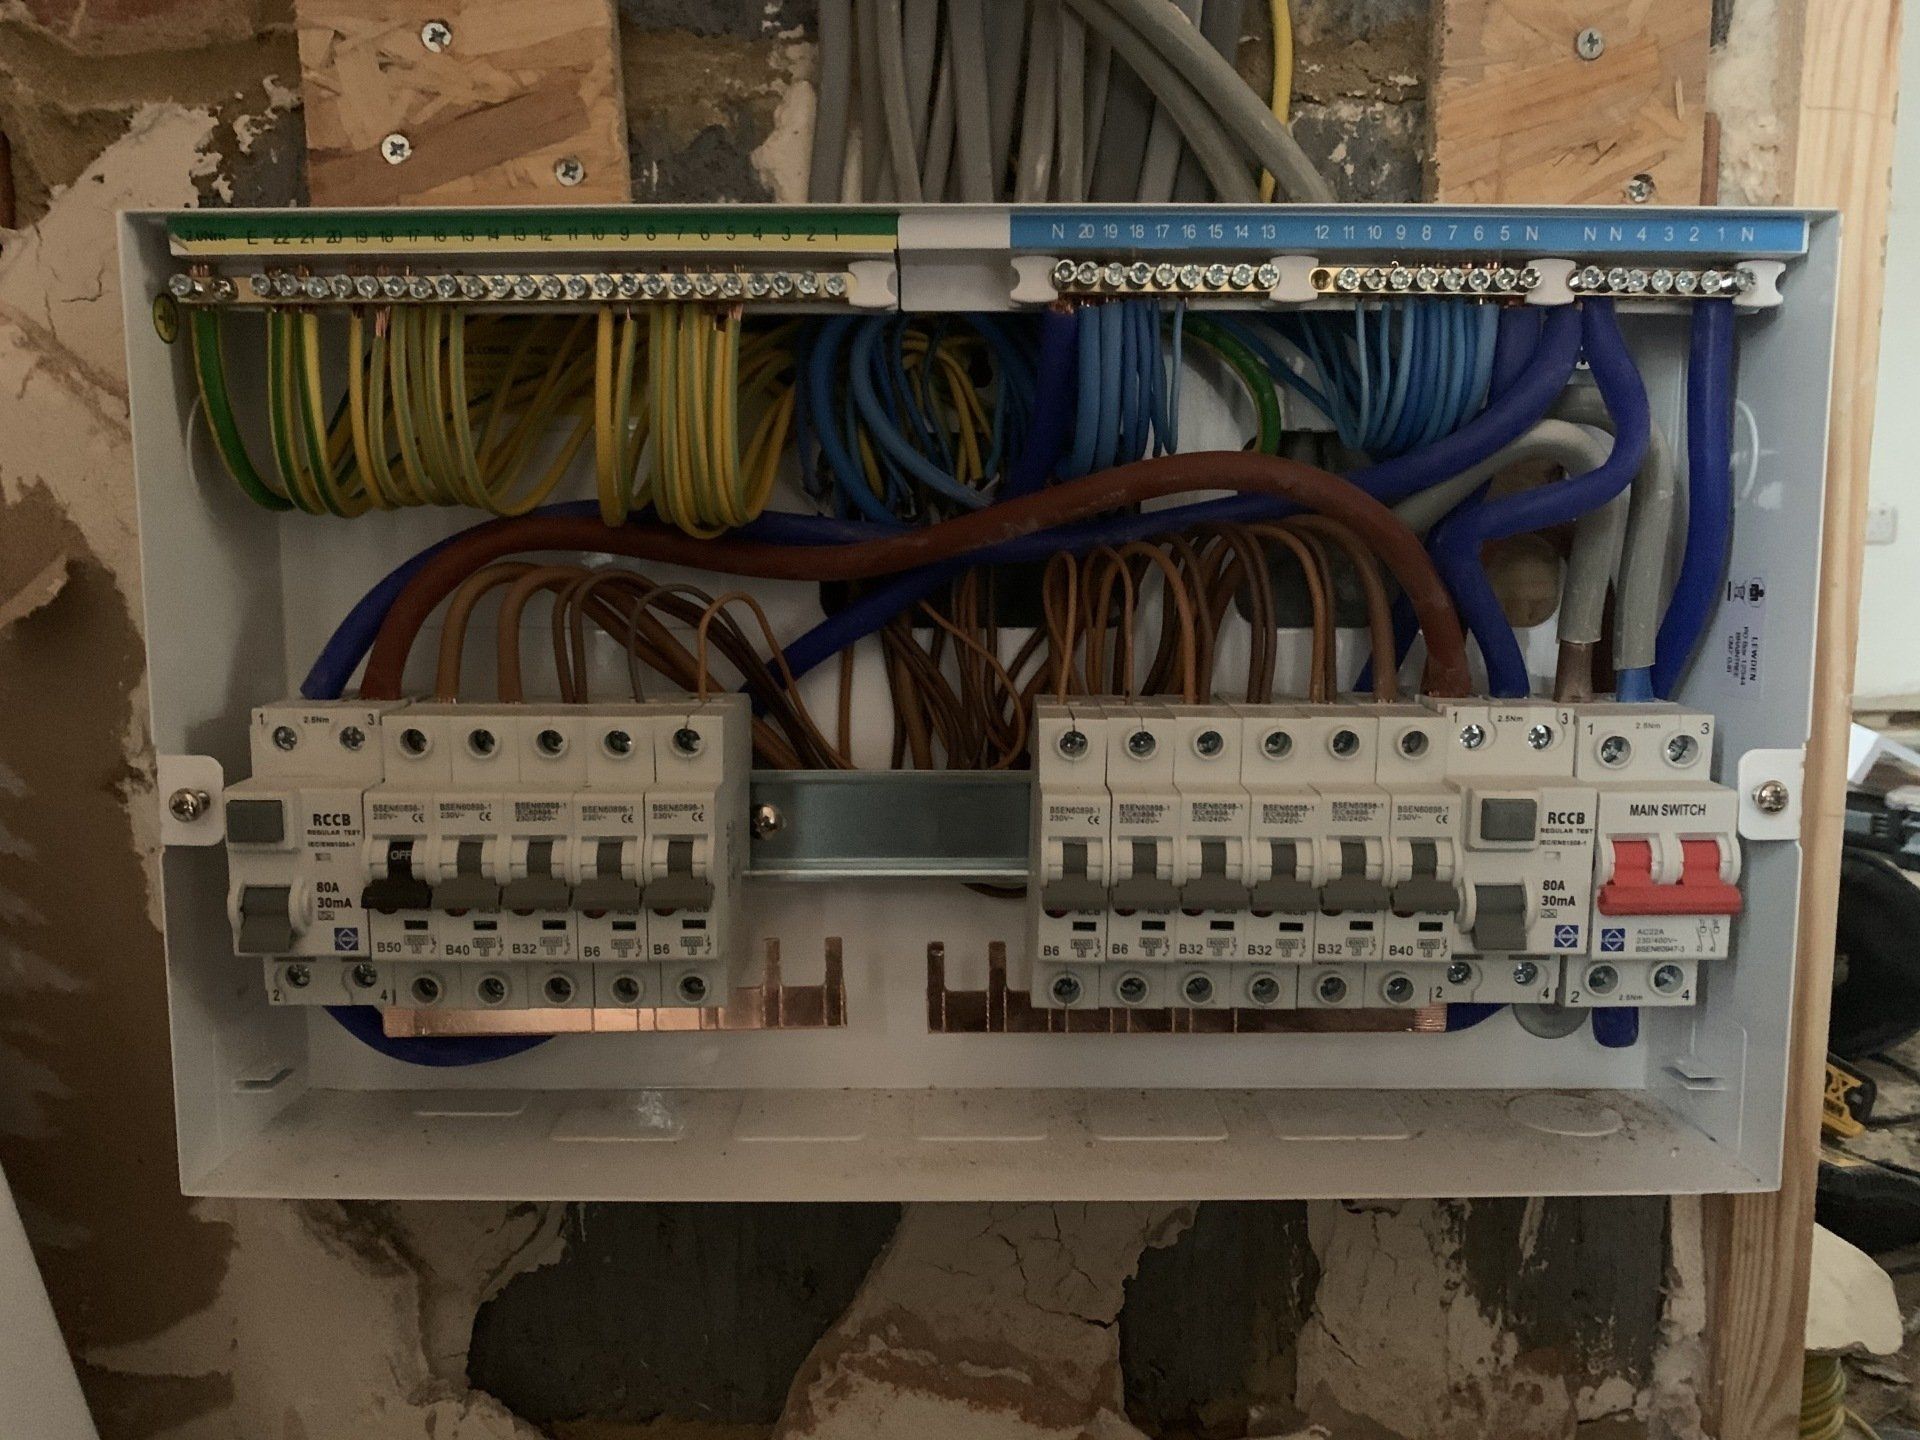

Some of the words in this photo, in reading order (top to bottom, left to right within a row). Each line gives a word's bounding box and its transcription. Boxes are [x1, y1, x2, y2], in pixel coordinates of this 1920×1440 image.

[274, 231, 290, 244] 22
[300, 231, 315, 244] 21
[326, 231, 342, 244] 20
[353, 230, 368, 243] 19
[379, 229, 394, 242] 18
[407, 229, 420, 242] 17
[432, 229, 447, 242] 16
[460, 229, 475, 242] 15
[486, 229, 500, 242] 14
[512, 229, 526, 242] 13
[538, 229, 553, 242] 12
[567, 229, 578, 242] 11
[591, 227, 605, 241] 10
[620, 226, 630, 241] 9
[646, 226, 656, 241] 8
[675, 226, 684, 241] 7
[700, 226, 710, 241] 6
[726, 226, 736, 241] 5
[752, 226, 763, 241] 4
[781, 226, 791, 241] 3
[806, 226, 816, 241] 2
[832, 226, 839, 241] 1
[1052, 224, 1064, 239] N
[1078, 224, 1095, 239] 20
[1103, 224, 1118, 239] 19
[1130, 224, 1144, 239] 18
[1156, 224, 1170, 239] 17
[1182, 224, 1197, 239] 16
[1209, 224, 1223, 239] 15
[1234, 224, 1249, 239] 14
[1261, 224, 1275, 239] 13
[1315, 224, 1329, 239] 12
[1343, 224, 1355, 239] 11
[1368, 224, 1382, 239] 10
[1396, 224, 1406, 239] 9
[1421, 226, 1432, 241] 8
[1448, 226, 1457, 241] 7
[1473, 226, 1483, 241] 6
[1500, 226, 1510, 241] 5
[1526, 226, 1538, 241] N
[1584, 226, 1597, 242] N
[1610, 226, 1623, 242] N
[1637, 226, 1647, 242] 4
[1664, 226, 1674, 242] 3
[1689, 226, 1699, 242] 2
[1718, 226, 1725, 242] 1
[1741, 226, 1754, 242] N
[1750, 636, 1758, 681] LEWDEN
[259, 713, 265, 725] 1
[368, 713, 375, 725] 3
[1453, 711, 1458, 724] 1
[1497, 715, 1523, 723] 2.5Nm
[1561, 713, 1568, 725] 3
[1587, 723, 1594, 735] 1
[1700, 722, 1710, 735] 3
[1630, 804, 1659, 816] MAIN
[1661, 803, 1707, 816] SWITCH
[313, 813, 351, 827] RCCB
[1547, 812, 1586, 825] RCCB
[391, 850, 412, 860] OFF
[316, 881, 339, 893] 80A
[1543, 880, 1565, 891] 80A
[317, 897, 353, 909] 30mA
[1541, 895, 1576, 906] 30mA
[377, 942, 402, 953] B50
[446, 944, 470, 956] B40
[512, 943, 537, 954] B32
[584, 946, 601, 957] B6
[653, 944, 670, 955] B6
[1043, 945, 1060, 956] B6
[1112, 944, 1129, 955] B6
[1179, 944, 1203, 955] B32
[1248, 944, 1272, 956] B32
[1318, 943, 1342, 955] B32
[1389, 945, 1413, 956] B40
[273, 990, 280, 1002] 2
[380, 990, 388, 1001] 4
[1435, 987, 1443, 998] 2
[1543, 987, 1550, 999] 4
[1570, 991, 1580, 1003] 2
[1682, 990, 1690, 1001] 4
